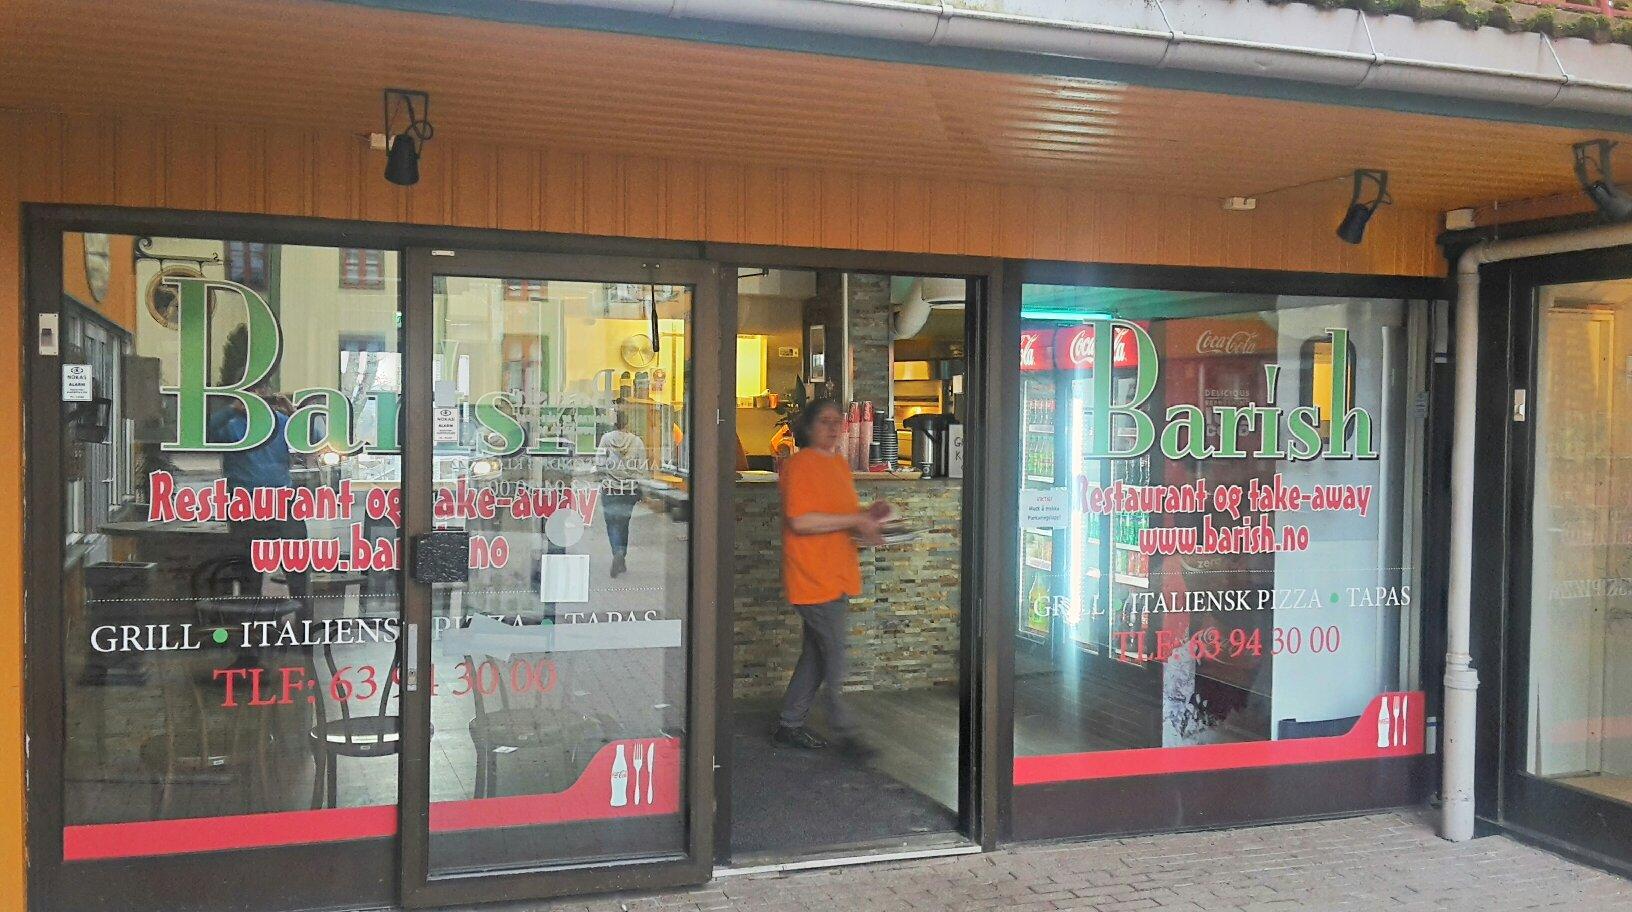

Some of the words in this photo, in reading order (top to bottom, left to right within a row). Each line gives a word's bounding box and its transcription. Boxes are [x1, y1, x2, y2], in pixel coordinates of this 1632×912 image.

[1083, 318, 1379, 461] Barish
[148, 469, 354, 522] Restaurant
[366, 486, 402, 530] og
[432, 472, 599, 527] ake-away
[1076, 474, 1208, 515] Restaurant
[1213, 484, 1243, 519] og
[1248, 472, 1372, 517] take-away
[1139, 513, 1310, 555] www.barish.no
[1131, 589, 1251, 614] ITALIENSK
[1257, 588, 1323, 611] PIZZA
[1346, 586, 1411, 607] TAPAS
[90, 623, 201, 653] GRILL
[241, 617, 401, 648] ITALIENS
[1188, 626, 1222, 660] 63
[1229, 626, 1262, 659] 94
[1270, 626, 1302, 656] 30
[1309, 625, 1341, 654] 00
[213, 666, 316, 709] TLF:
[330, 664, 378, 701] 63
[453, 658, 500, 696] 30
[511, 656, 558, 694] 00
